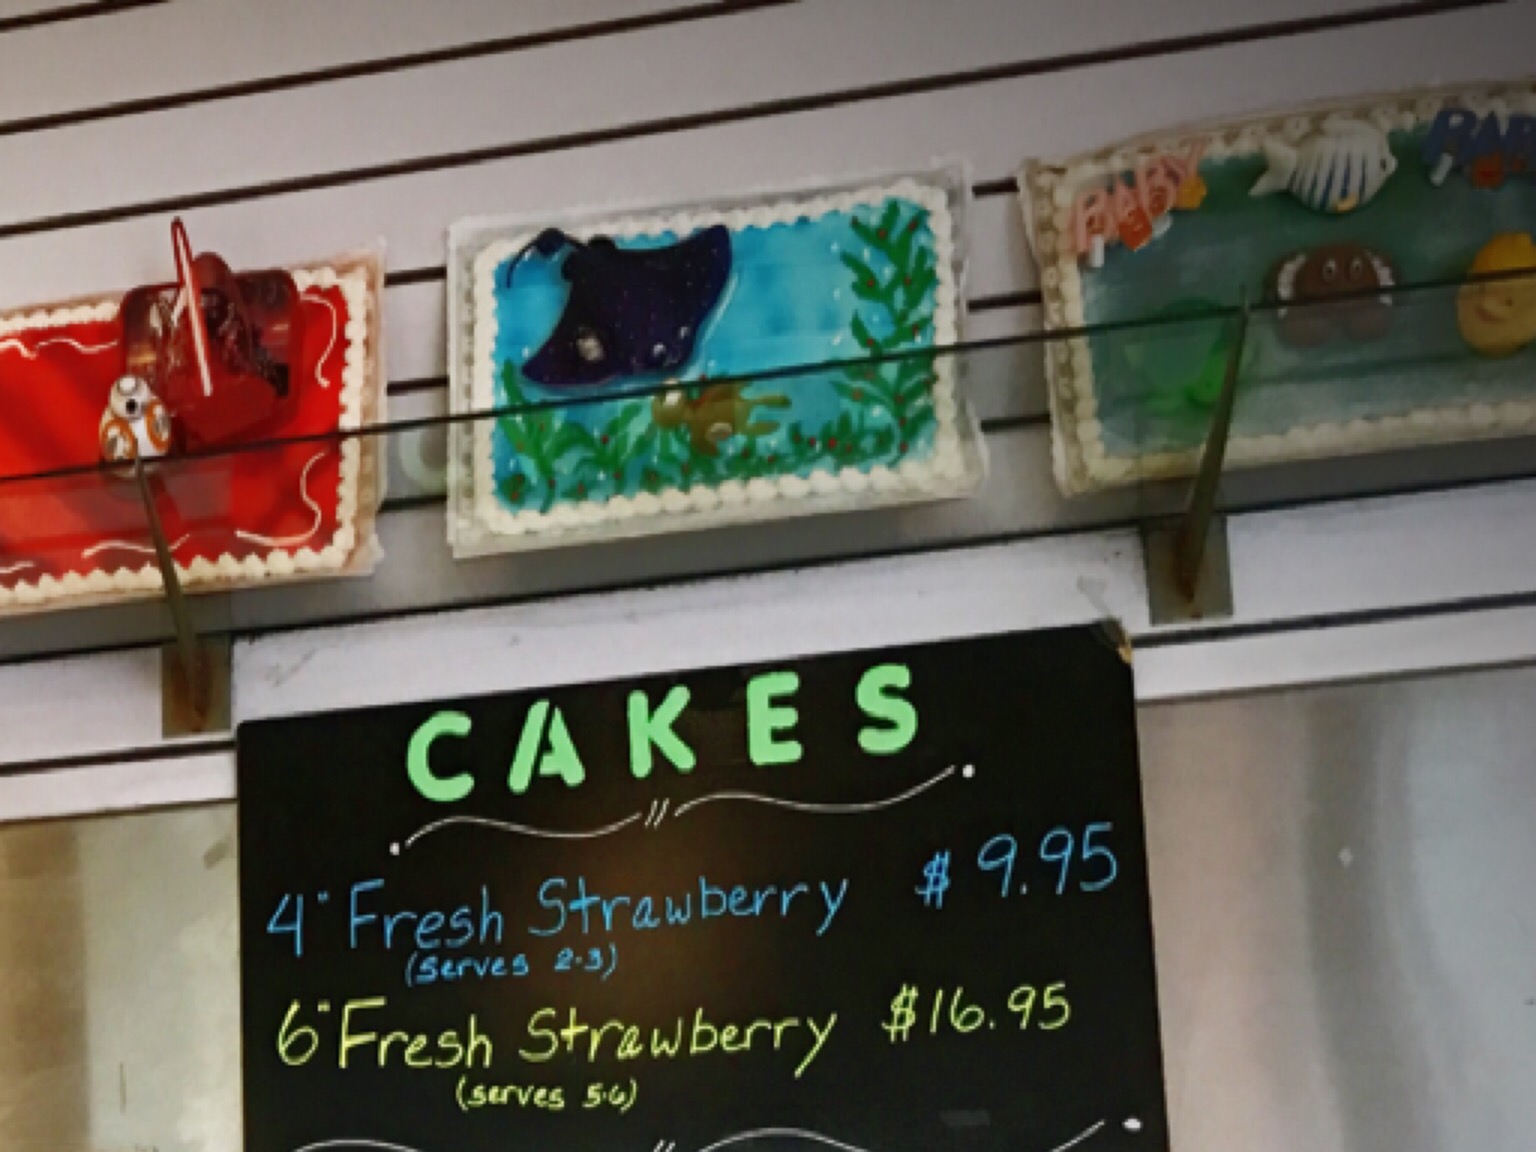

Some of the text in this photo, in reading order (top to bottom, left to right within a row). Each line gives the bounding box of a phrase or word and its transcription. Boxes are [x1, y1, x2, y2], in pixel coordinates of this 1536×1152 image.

[406, 663, 919, 803] CAKES
[349, 879, 503, 951] Fresh
[528, 875, 852, 938] Strawberry
[976, 821, 1120, 898] 9.95
[338, 996, 494, 1069] Fresh
[518, 1005, 839, 1079] Strawberry
[881, 982, 1073, 1045] $16.95
